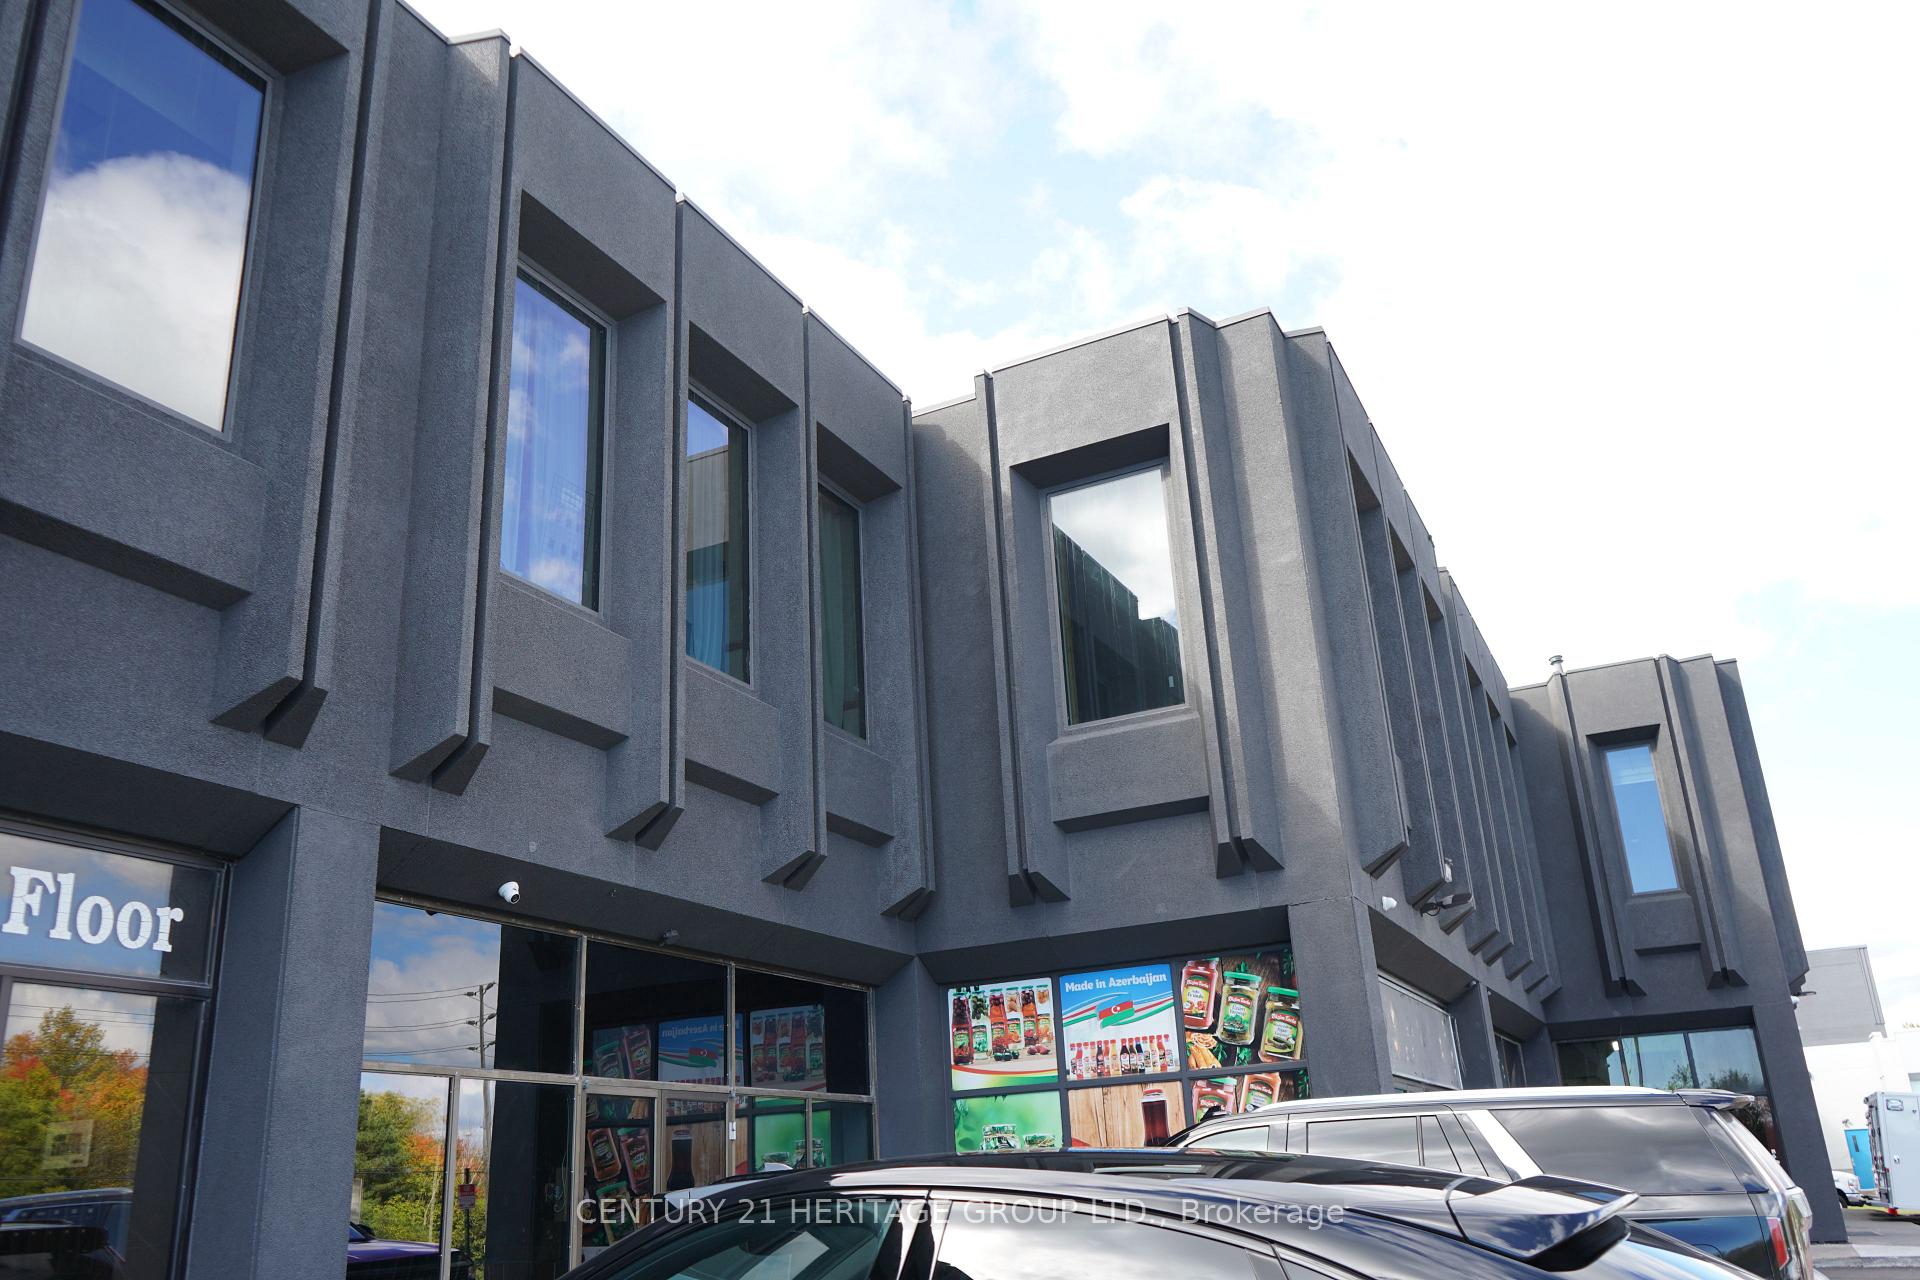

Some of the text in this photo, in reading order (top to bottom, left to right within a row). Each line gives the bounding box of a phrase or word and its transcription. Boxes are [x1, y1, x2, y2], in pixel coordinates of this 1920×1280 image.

[2, 866, 184, 952] Floor
[1065, 972, 1167, 992] Made in Azerbaijan
